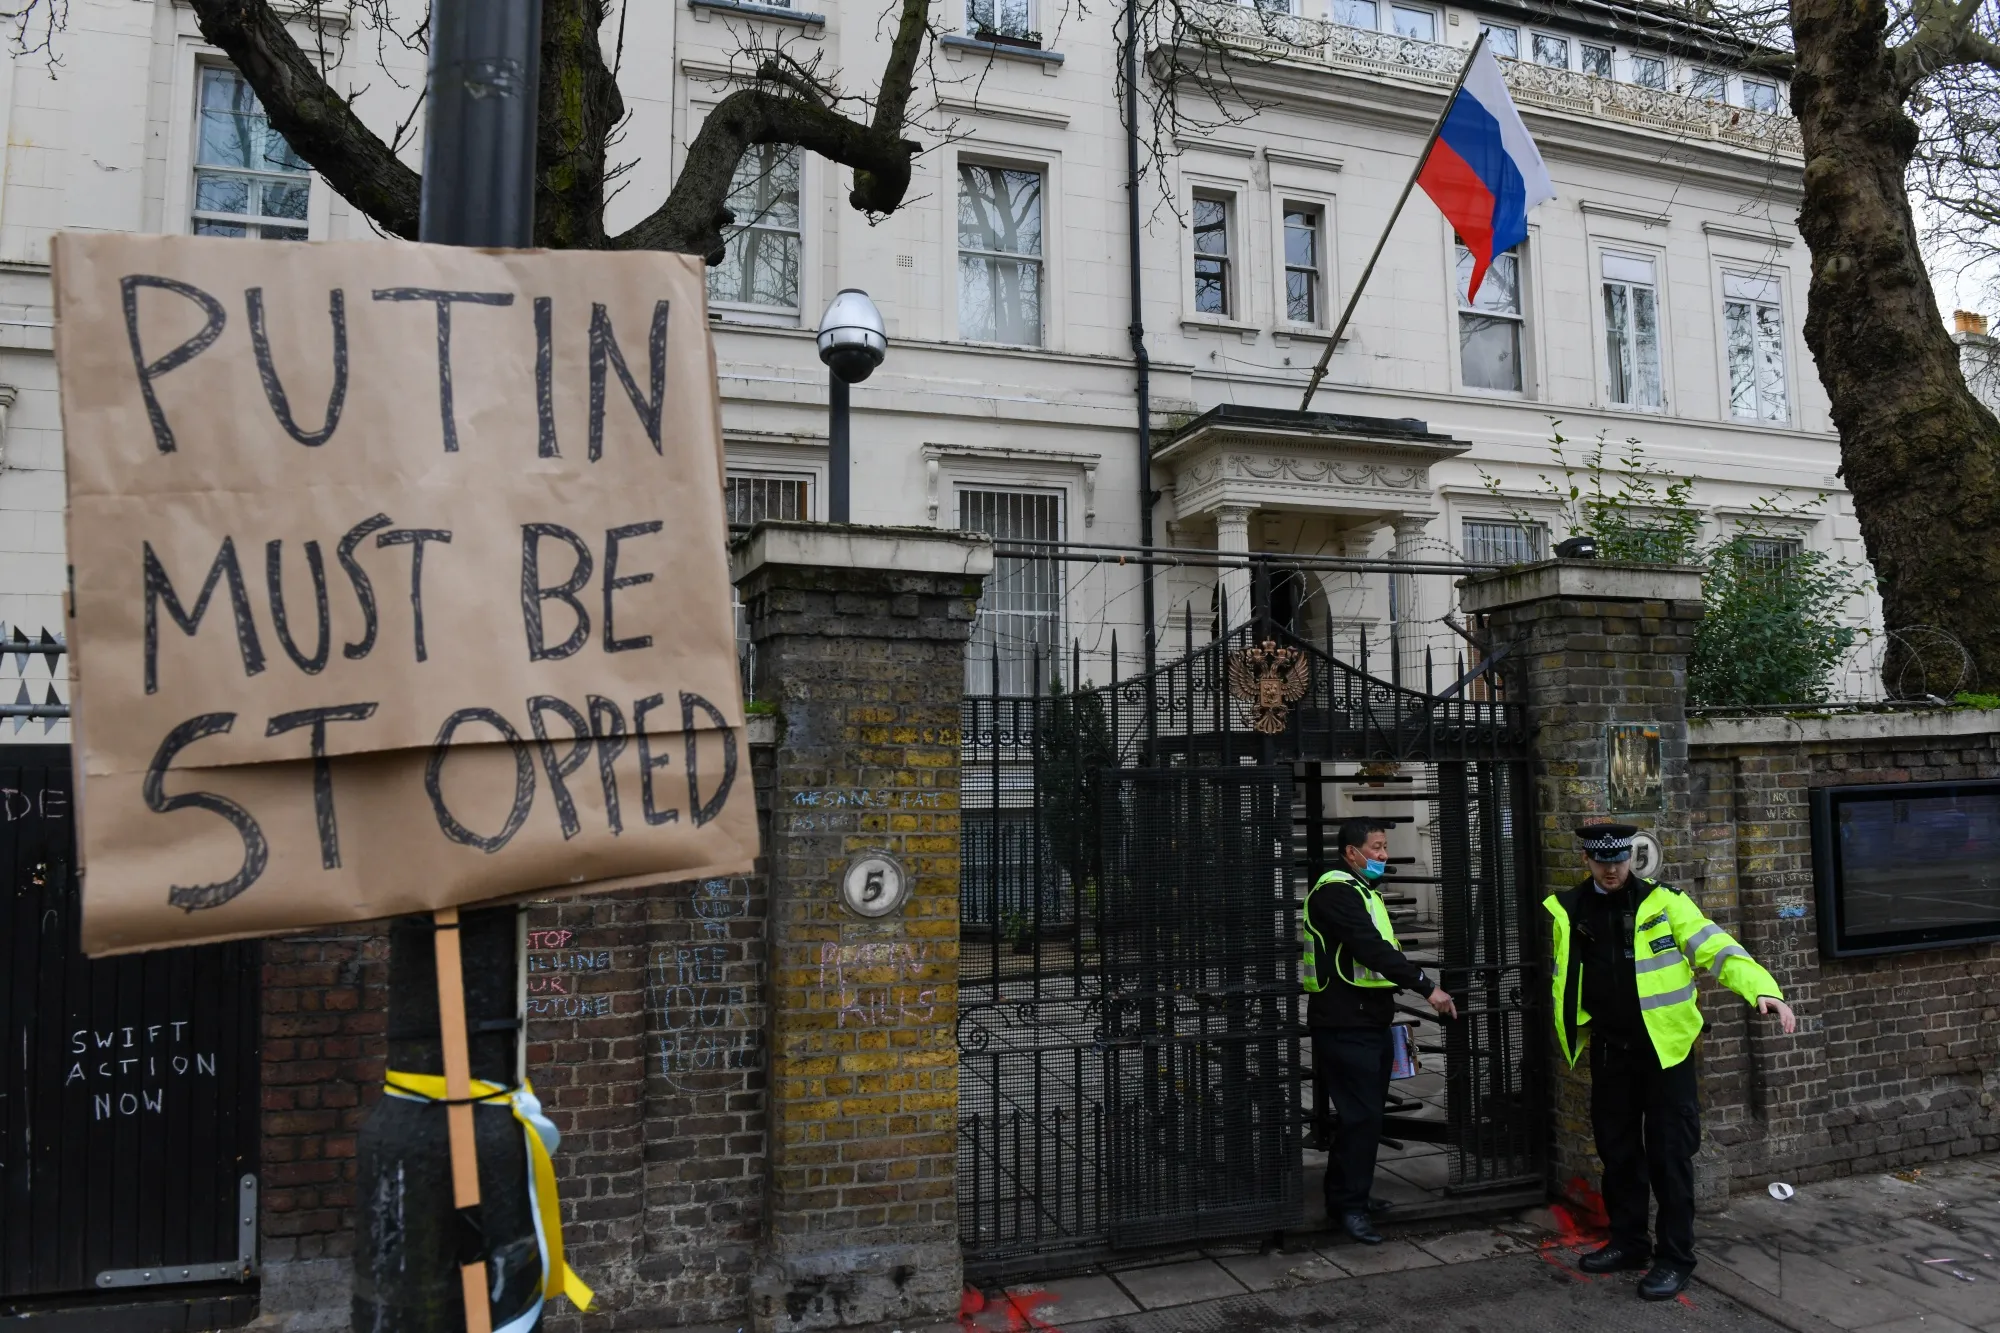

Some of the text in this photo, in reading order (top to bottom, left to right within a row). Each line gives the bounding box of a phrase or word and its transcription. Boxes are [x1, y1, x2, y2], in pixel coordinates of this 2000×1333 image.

[120, 274, 670, 463] PUTIN
[143, 512, 664, 695] MUST BE
[142, 690, 738, 913] STOPPED
[1636, 844, 1648, 870] 5
[862, 869, 884, 902] 5
[525, 976, 567, 995] UR
[72, 1021, 188, 1053] SWIFT
[65, 1052, 217, 1086] ACTION
[95, 1088, 163, 1120] NOW
